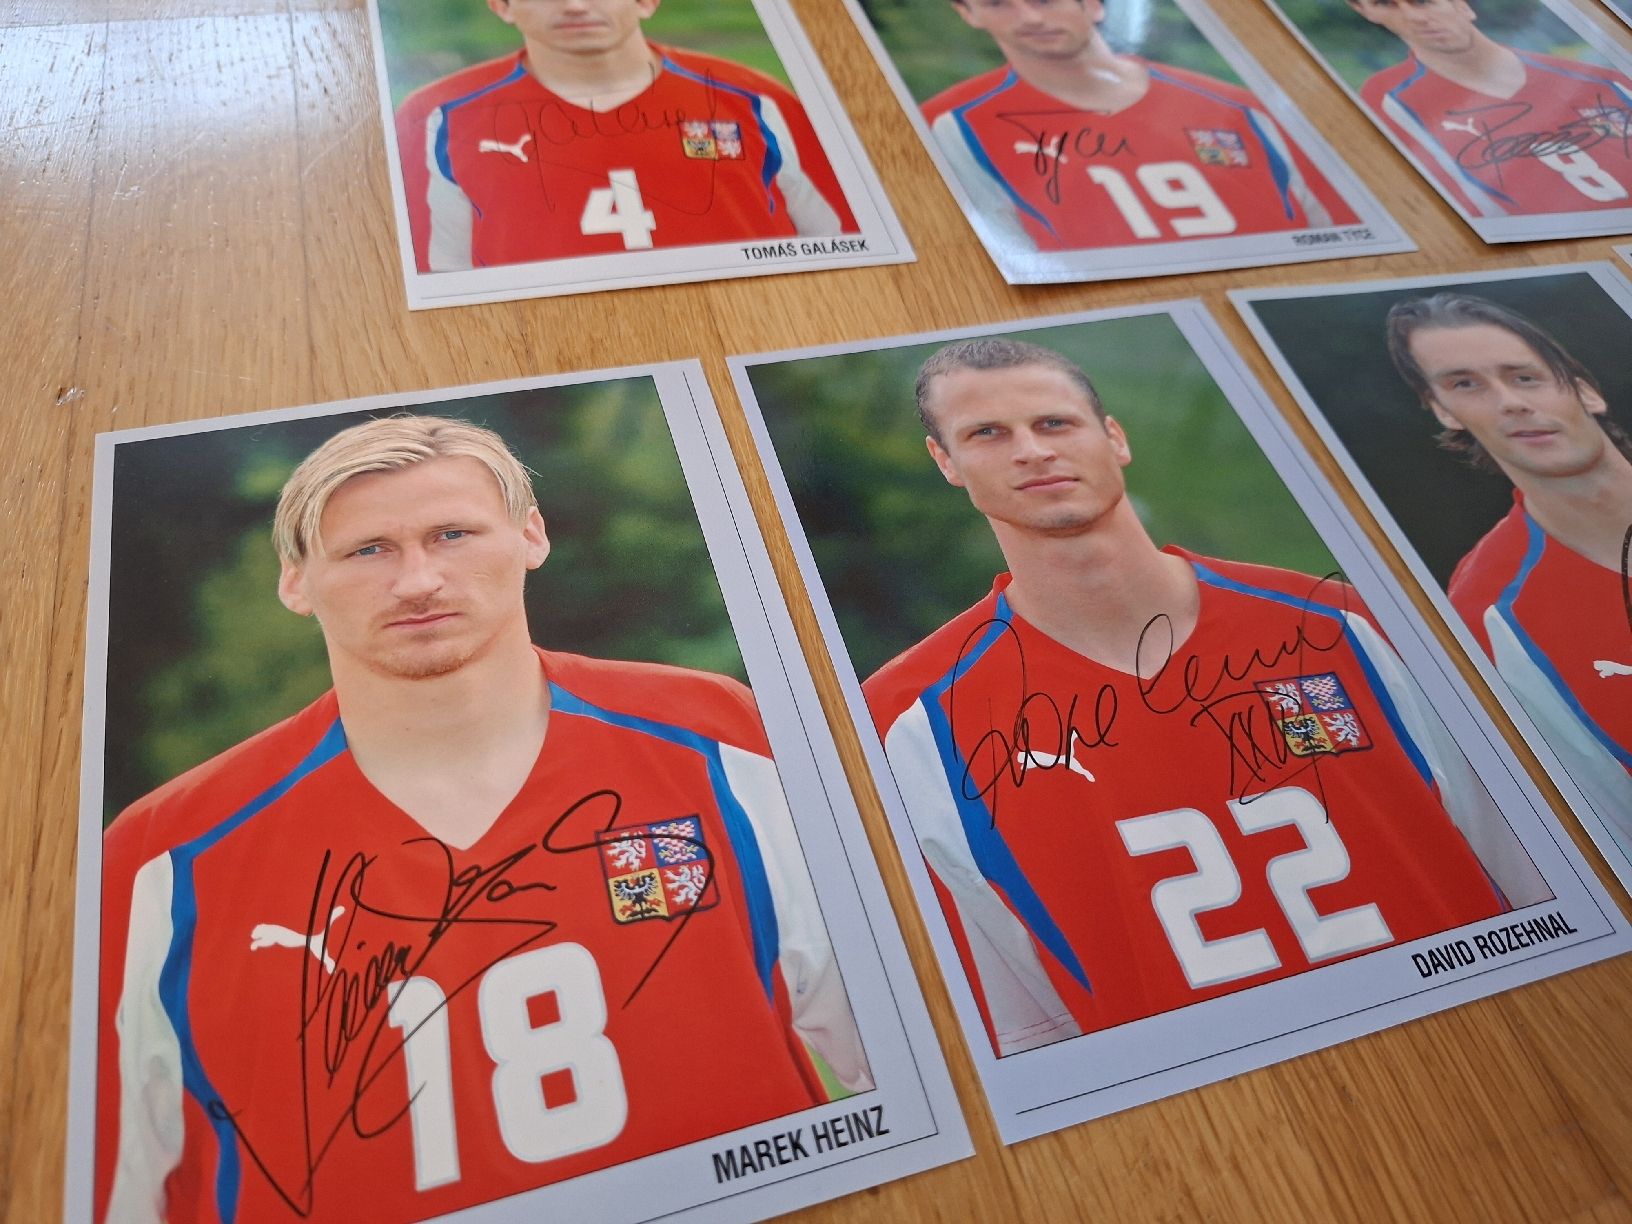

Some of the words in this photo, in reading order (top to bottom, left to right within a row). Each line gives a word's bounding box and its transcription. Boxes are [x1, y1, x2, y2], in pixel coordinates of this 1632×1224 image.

[580, 169, 657, 250] 4
[1086, 161, 1238, 239] 19
[1530, 140, 1629, 202] 8
[741, 242, 798, 260] TOMÁŠ
[801, 238, 870, 256] GALÁSEK
[1115, 786, 1394, 990] 22
[1411, 939, 1476, 979] DAVID
[1472, 911, 1578, 960] ROZEHNAL
[386, 941, 628, 1192] 18
[712, 1128, 809, 1184] MAREK
[811, 1104, 890, 1154] HEINZ
